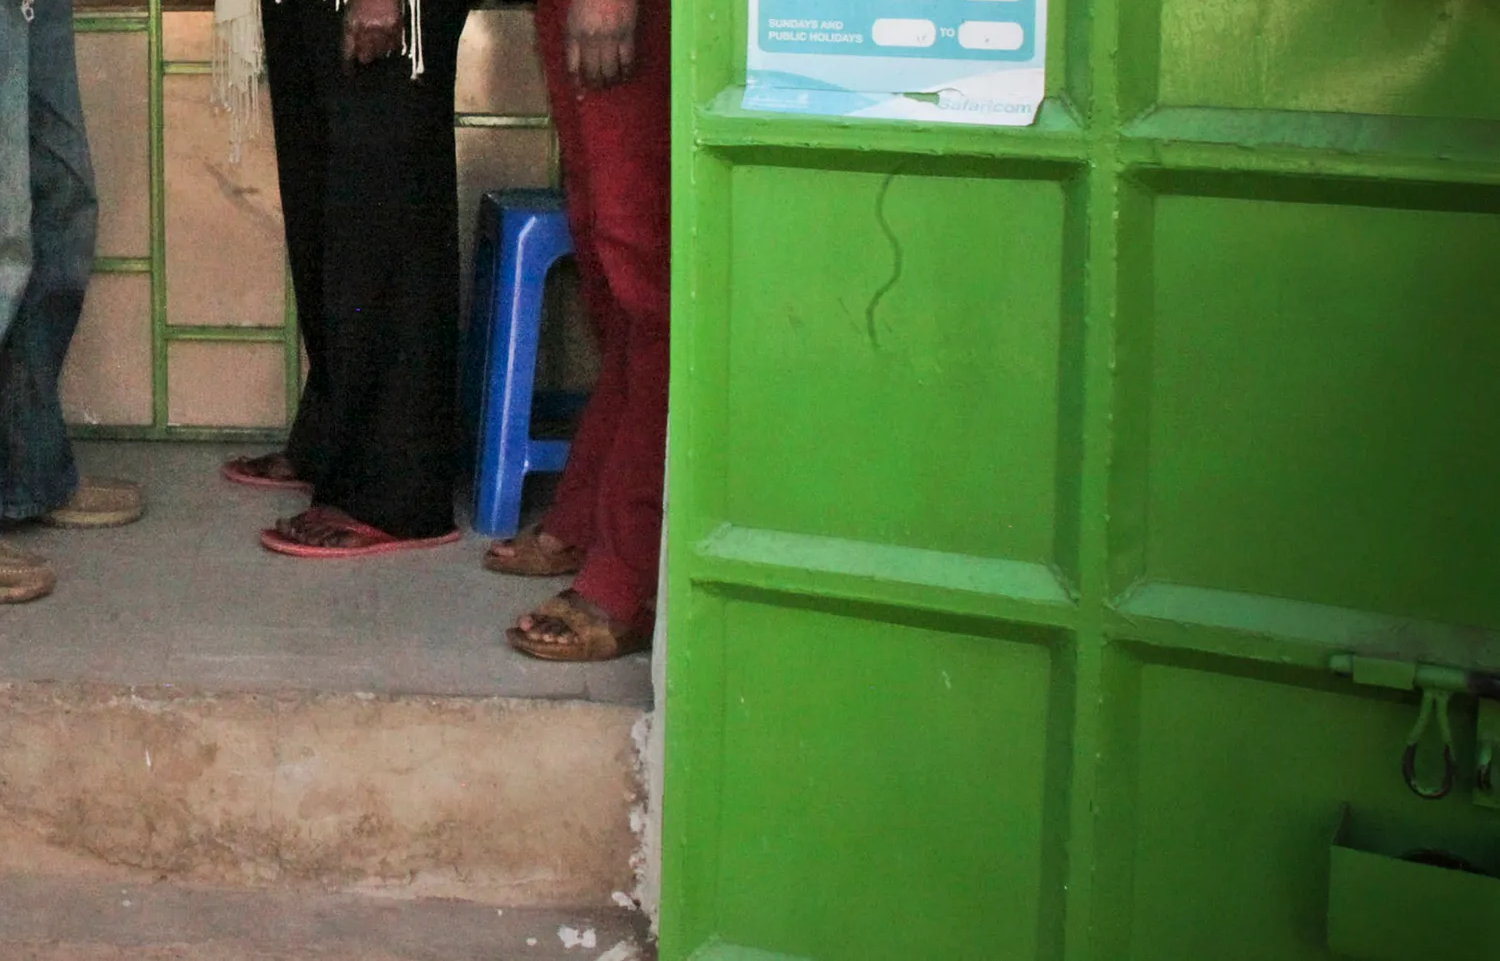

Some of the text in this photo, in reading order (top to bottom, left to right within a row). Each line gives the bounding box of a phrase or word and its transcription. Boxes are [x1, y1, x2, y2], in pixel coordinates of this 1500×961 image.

[768, 18, 955, 37] SUNDAYS AND TO
[768, 30, 864, 44] PUBLIC HOLIDAYS
